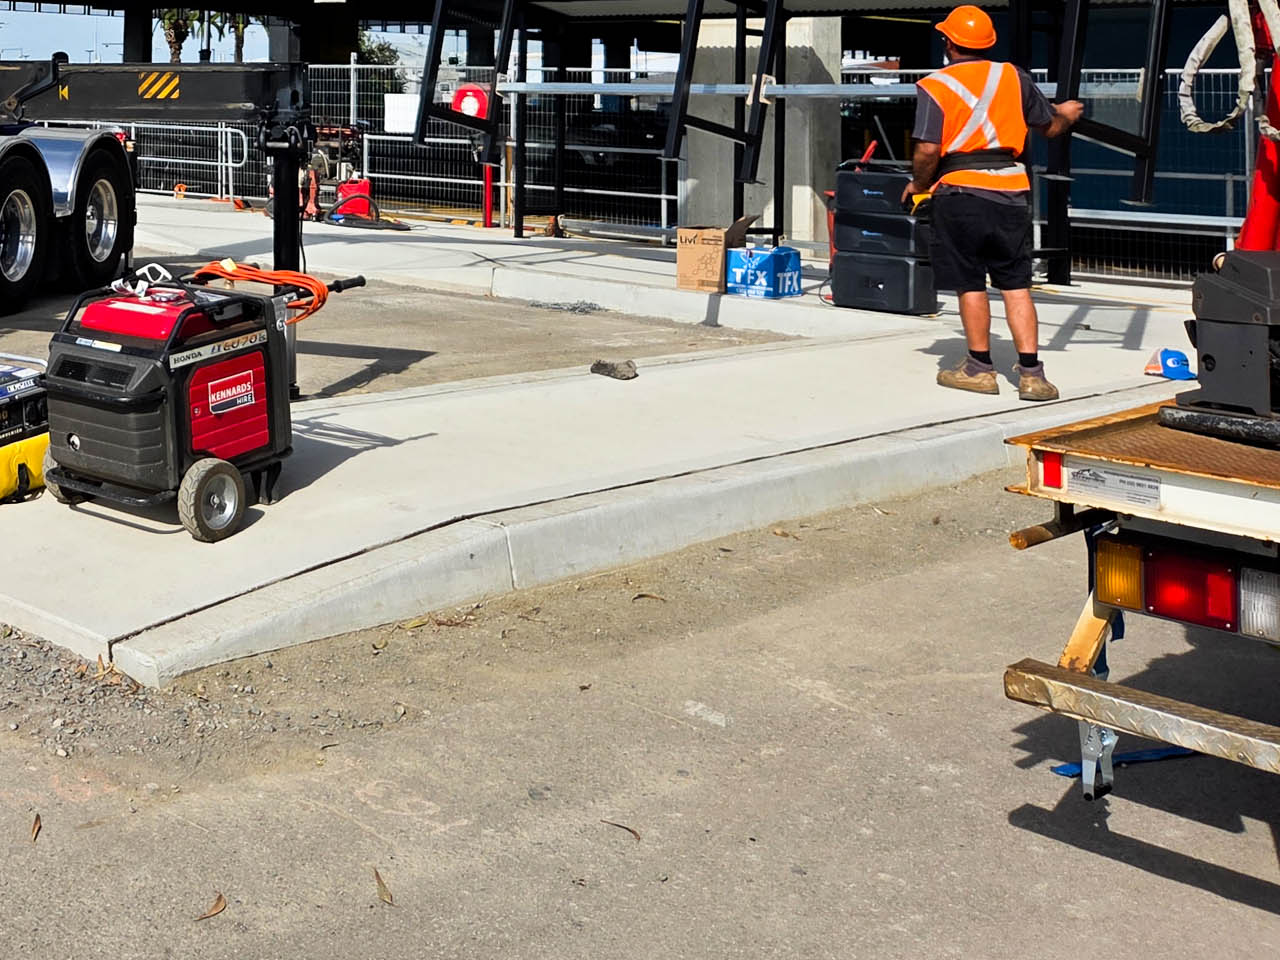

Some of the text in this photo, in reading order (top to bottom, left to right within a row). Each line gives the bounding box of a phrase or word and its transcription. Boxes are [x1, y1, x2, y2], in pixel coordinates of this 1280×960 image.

[732, 268, 768, 286] TFX
[776, 270, 799, 294] TFX
[173, 351, 202, 365] HONDA
[211, 381, 252, 402] KENNARDS
[236, 394, 252, 405] HIRE
